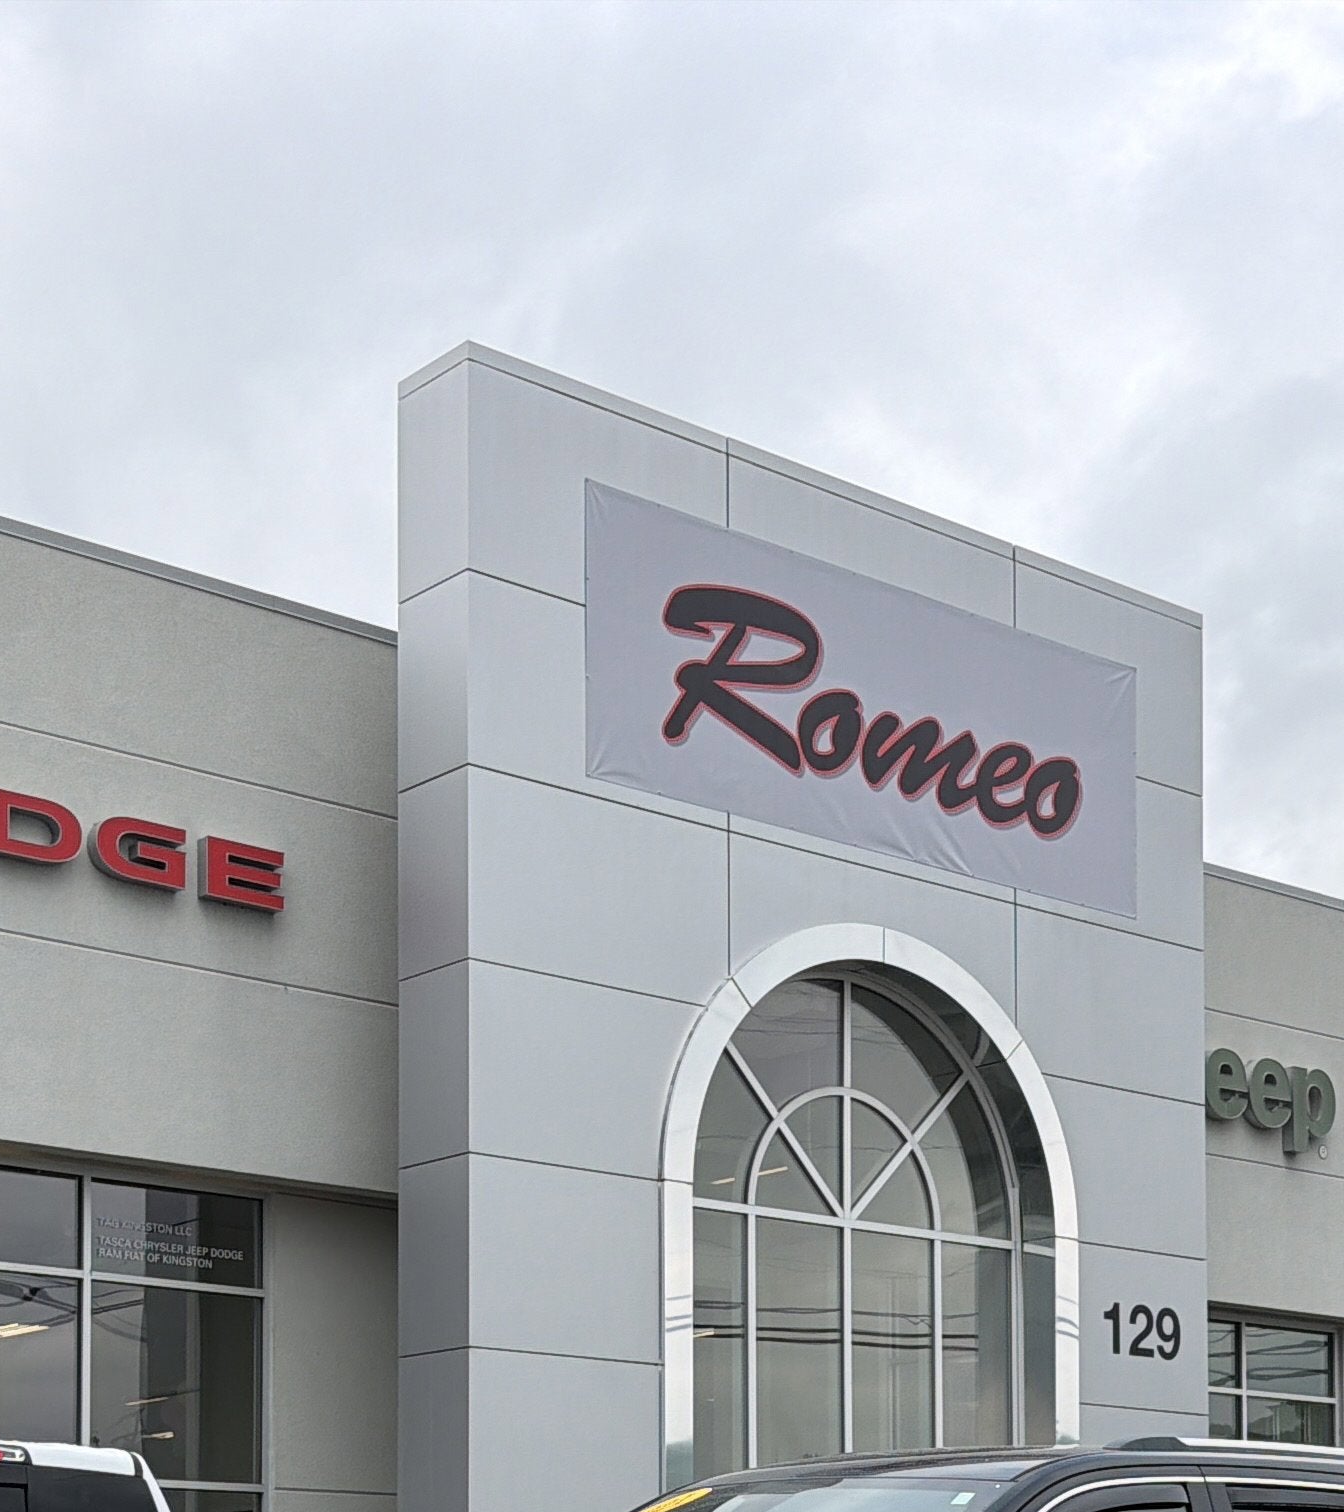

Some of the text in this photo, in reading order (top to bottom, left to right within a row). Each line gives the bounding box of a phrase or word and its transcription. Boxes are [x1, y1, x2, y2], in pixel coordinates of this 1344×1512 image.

[662, 584, 1082, 840] Romeo
[1205, 1047, 1336, 1153] eep
[98, 1236, 244, 1260] TASCA CHRYSLER JEEP DODGE
[175, 1226, 192, 1236] LLC
[98, 1248, 122, 1259] RAM
[147, 1252, 160, 1263] OF
[162, 1255, 213, 1269] KINGSTON
[1104, 1302, 1182, 1360] 129
